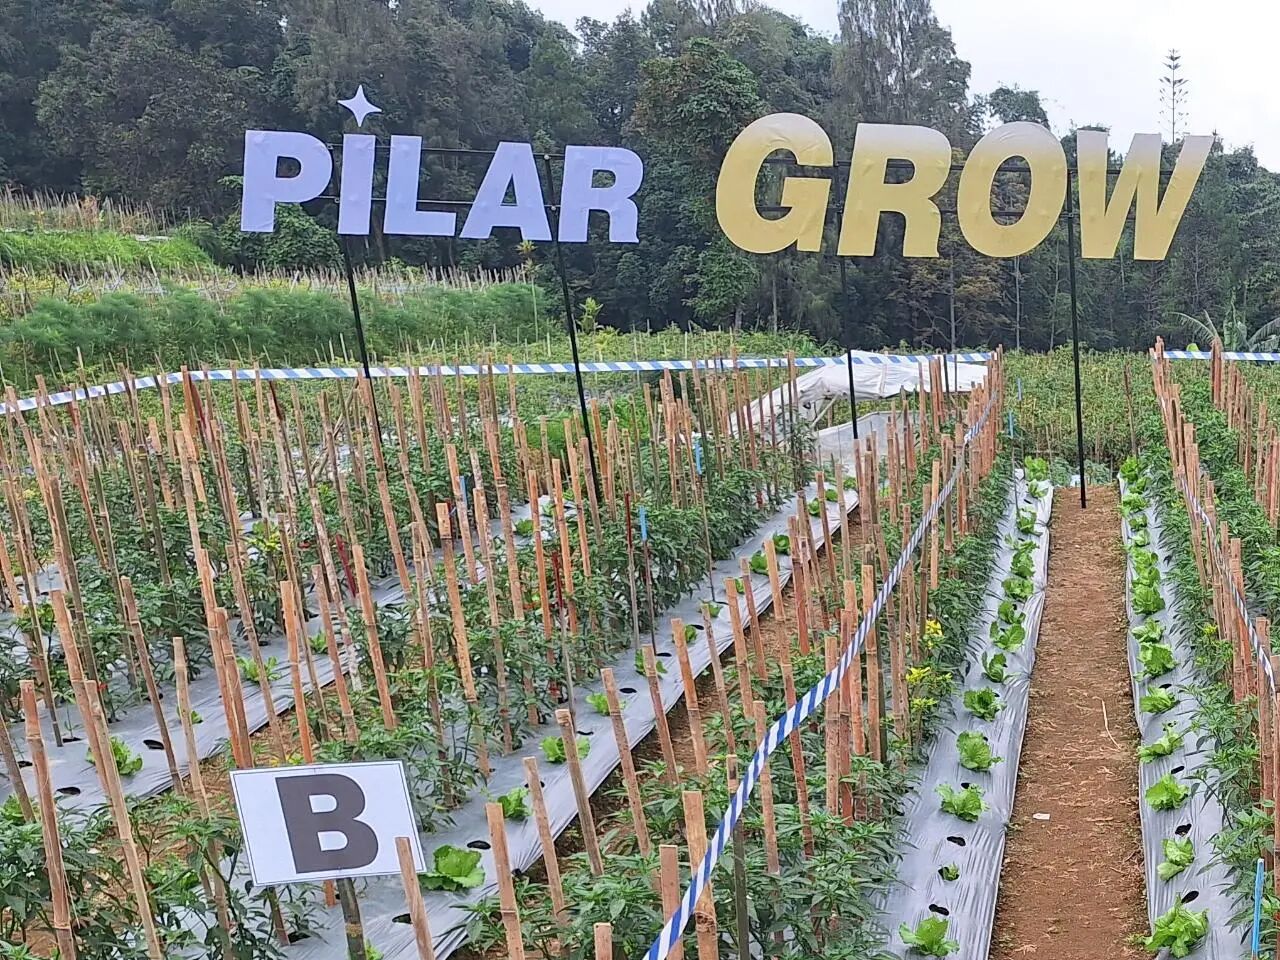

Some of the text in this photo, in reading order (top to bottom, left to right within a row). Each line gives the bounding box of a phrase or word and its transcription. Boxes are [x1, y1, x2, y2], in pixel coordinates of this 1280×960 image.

[240, 112, 1216, 261] PILAR GROW
[275, 773, 378, 874] B
